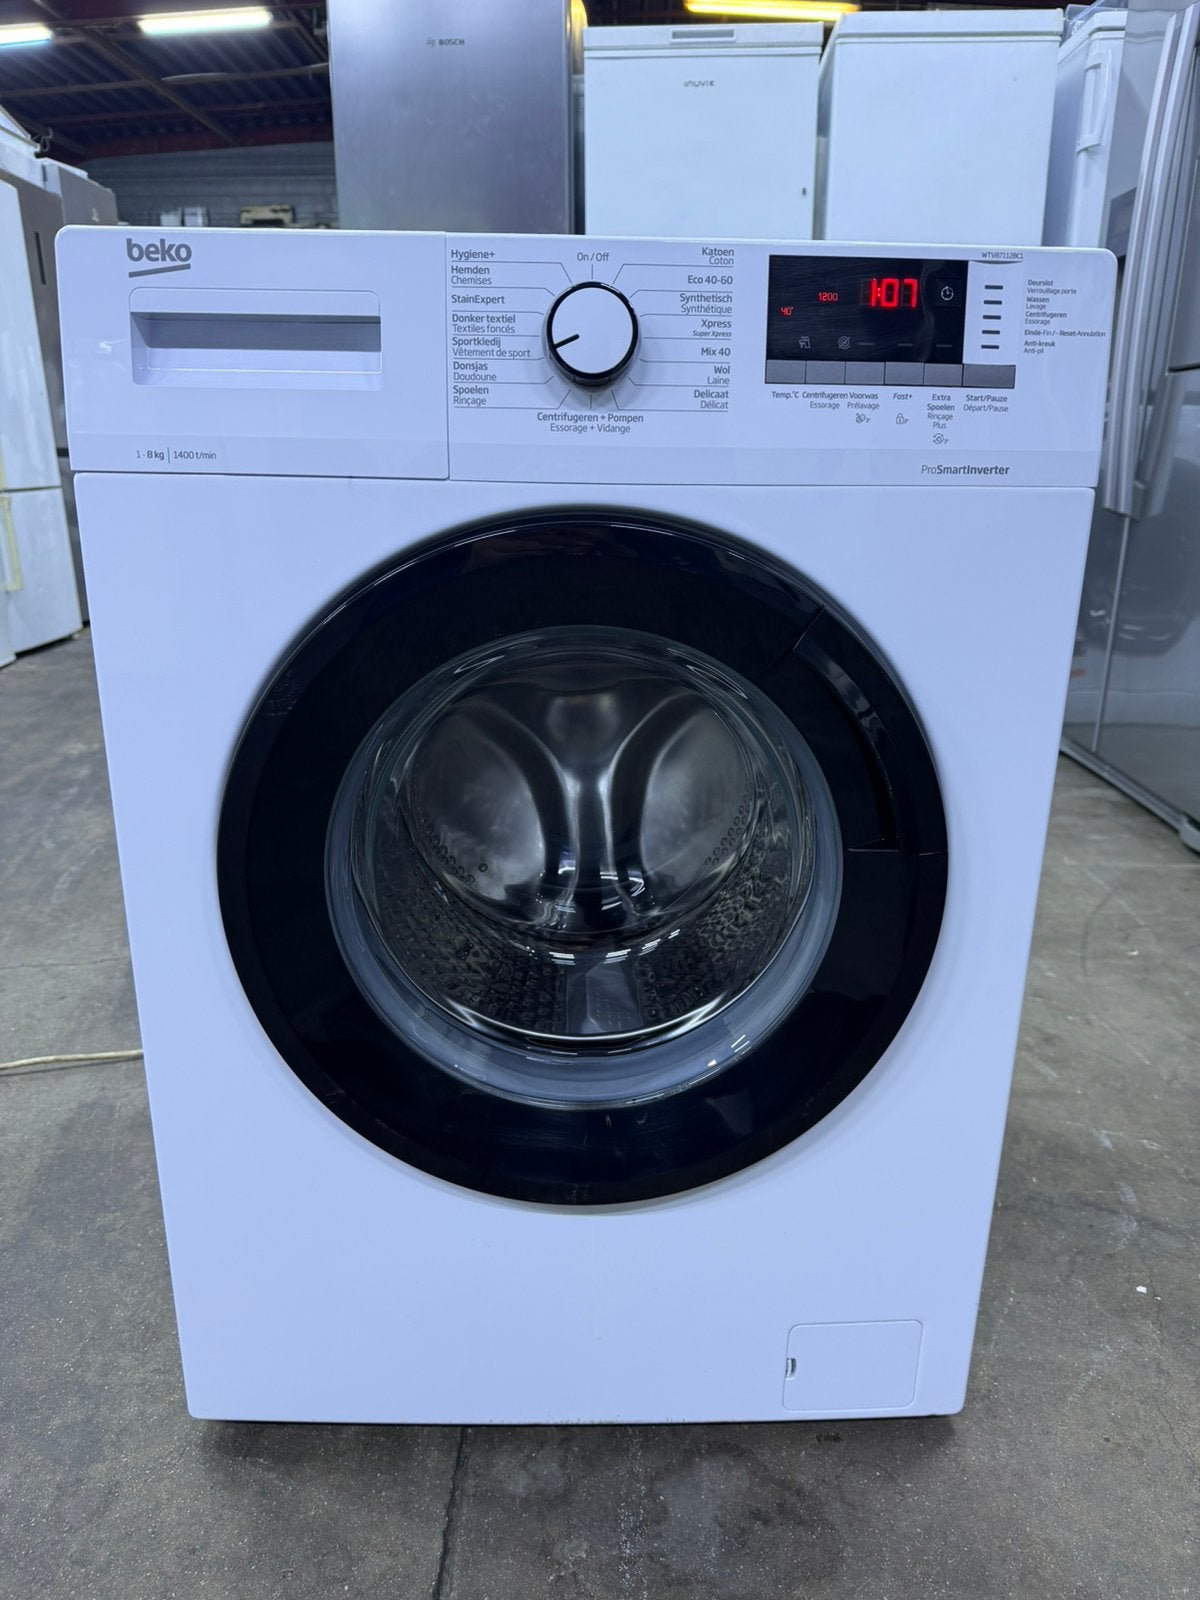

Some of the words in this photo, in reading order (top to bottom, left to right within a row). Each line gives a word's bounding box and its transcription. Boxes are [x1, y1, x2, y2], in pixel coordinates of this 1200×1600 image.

[126, 238, 192, 262] beko
[451, 249, 495, 260] Hygiene+
[701, 246, 734, 257] Katoen
[577, 252, 589, 262] On
[595, 252, 610, 262] Off
[708, 256, 734, 265] Coton
[451, 265, 490, 275] Hemden
[451, 275, 492, 285] Chemises
[687, 275, 703, 284] Eco
[704, 275, 733, 285] 40-60
[1027, 279, 1054, 287] Deurslot
[870, 278, 918, 308] 1:07
[1027, 287, 1061, 295] Verrouillage
[451, 294, 505, 305] StainExpert
[679, 292, 733, 304] Synthetisch
[818, 292, 838, 301] 1200
[681, 303, 733, 315] Synthétique
[452, 313, 485, 324] Donker
[486, 314, 516, 323] textiel
[1025, 311, 1067, 319] Centrifugeren
[701, 319, 732, 330] Xpress
[1024, 318, 1050, 326] Essorage
[452, 323, 485, 333] Textiles
[486, 323, 516, 334] foncés
[692, 329, 710, 338] Super
[711, 330, 732, 338] Xpress
[452, 336, 501, 348] Sportkledij
[452, 347, 494, 357] Vêtement
[495, 348, 507, 358] de
[508, 348, 531, 359] sport
[701, 347, 716, 356] Mix
[718, 347, 731, 357] 40
[453, 361, 488, 372] Donsjas
[713, 365, 730, 375] Wol
[453, 371, 497, 382] Doudoune
[707, 376, 730, 385] Laine
[453, 385, 489, 396] Spoelen
[693, 389, 729, 399] Delicaat
[453, 395, 487, 407] Rinçage
[802, 391, 848, 401] Centrifugeren
[849, 392, 879, 400] Voorwas
[893, 392, 913, 400] Fast+
[932, 393, 951, 401] Extra
[966, 394, 1008, 402] Start/Pauze
[700, 400, 729, 410] Délicat
[809, 401, 840, 410] Essorage
[847, 401, 880, 411] Prélavage
[927, 403, 955, 413] Spoelen
[963, 404, 1009, 413] Départ/Pause
[537, 412, 599, 423] Centrifugeren
[607, 413, 644, 424] Pompen
[927, 412, 953, 421] Rinçage
[550, 422, 588, 434] Essorage
[597, 424, 631, 435] Vidange
[932, 421, 947, 429] Plus
[136, 450, 141, 459] 1
[146, 450, 153, 459] 8
[154, 450, 165, 461] kg
[173, 450, 194, 459] 1400
[195, 450, 217, 460] t/min
[921, 464, 1010, 475] ProSmartInverter
